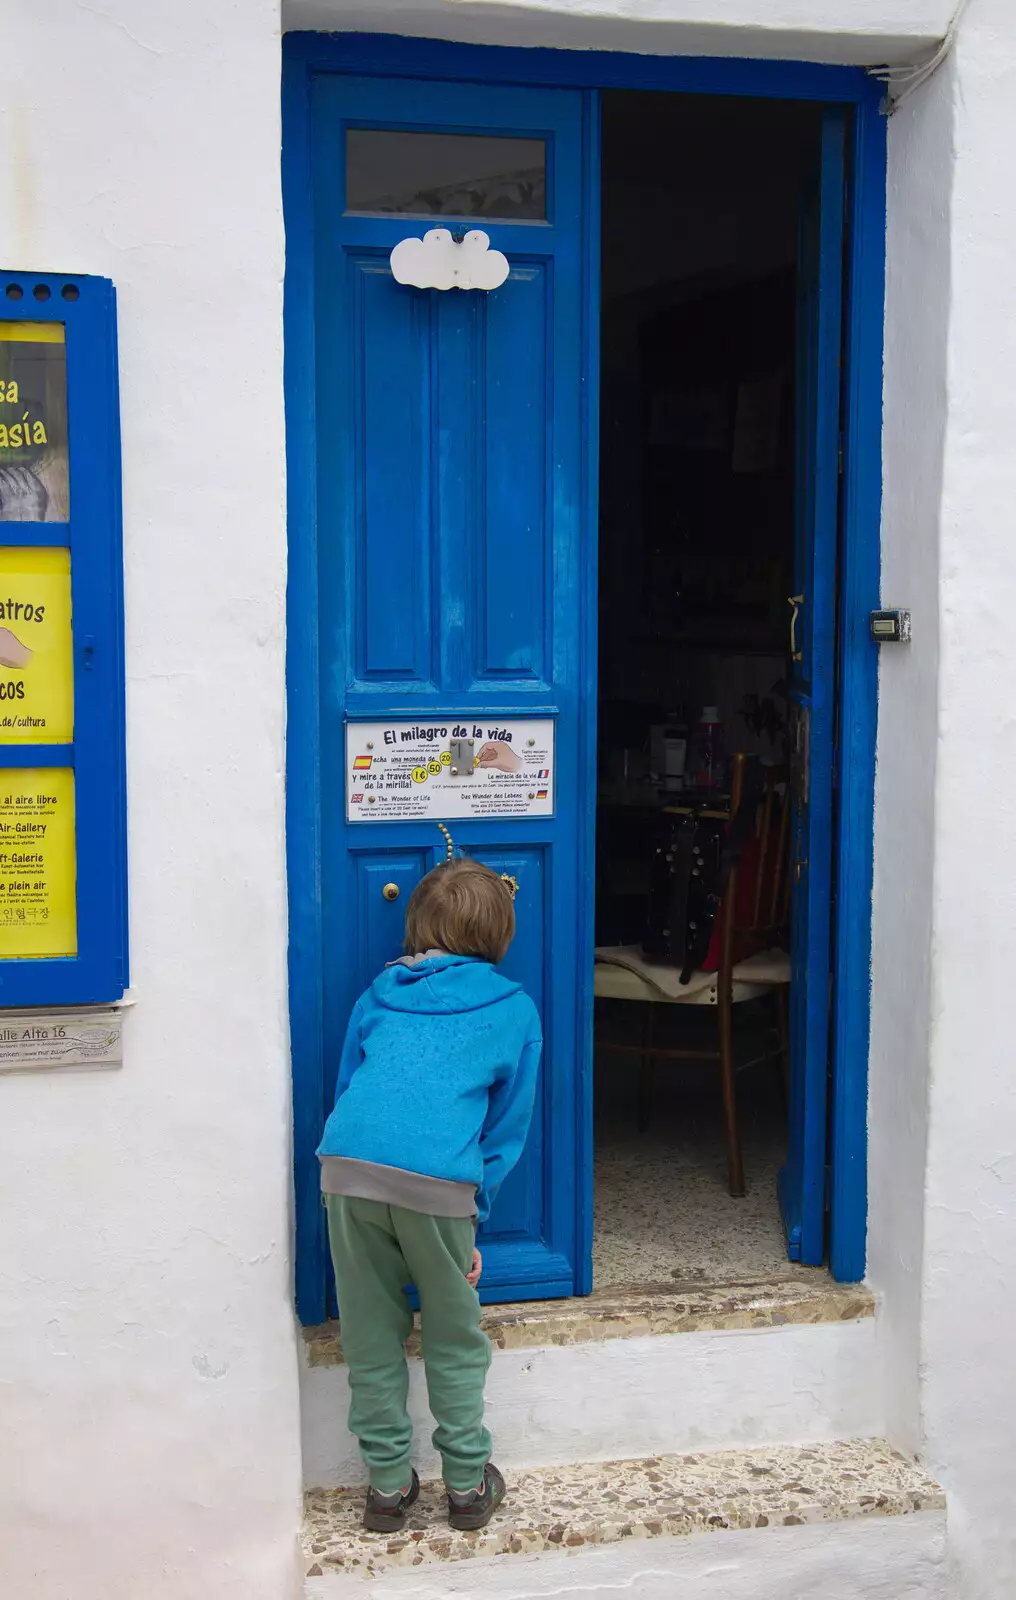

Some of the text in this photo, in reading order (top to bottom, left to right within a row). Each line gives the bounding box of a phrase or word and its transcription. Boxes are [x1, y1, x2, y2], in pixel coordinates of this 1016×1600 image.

[384, 725, 512, 745] El milagro de la vida
[387, 772, 410, 780] través
[386, 780, 412, 788] mirilla!
[4, 795, 58, 804] al aire libre
[9, 881, 30, 892] plein
[34, 881, 46, 889] air
[22, 1028, 48, 1039] Alta
[53, 1027, 66, 1037] 16
